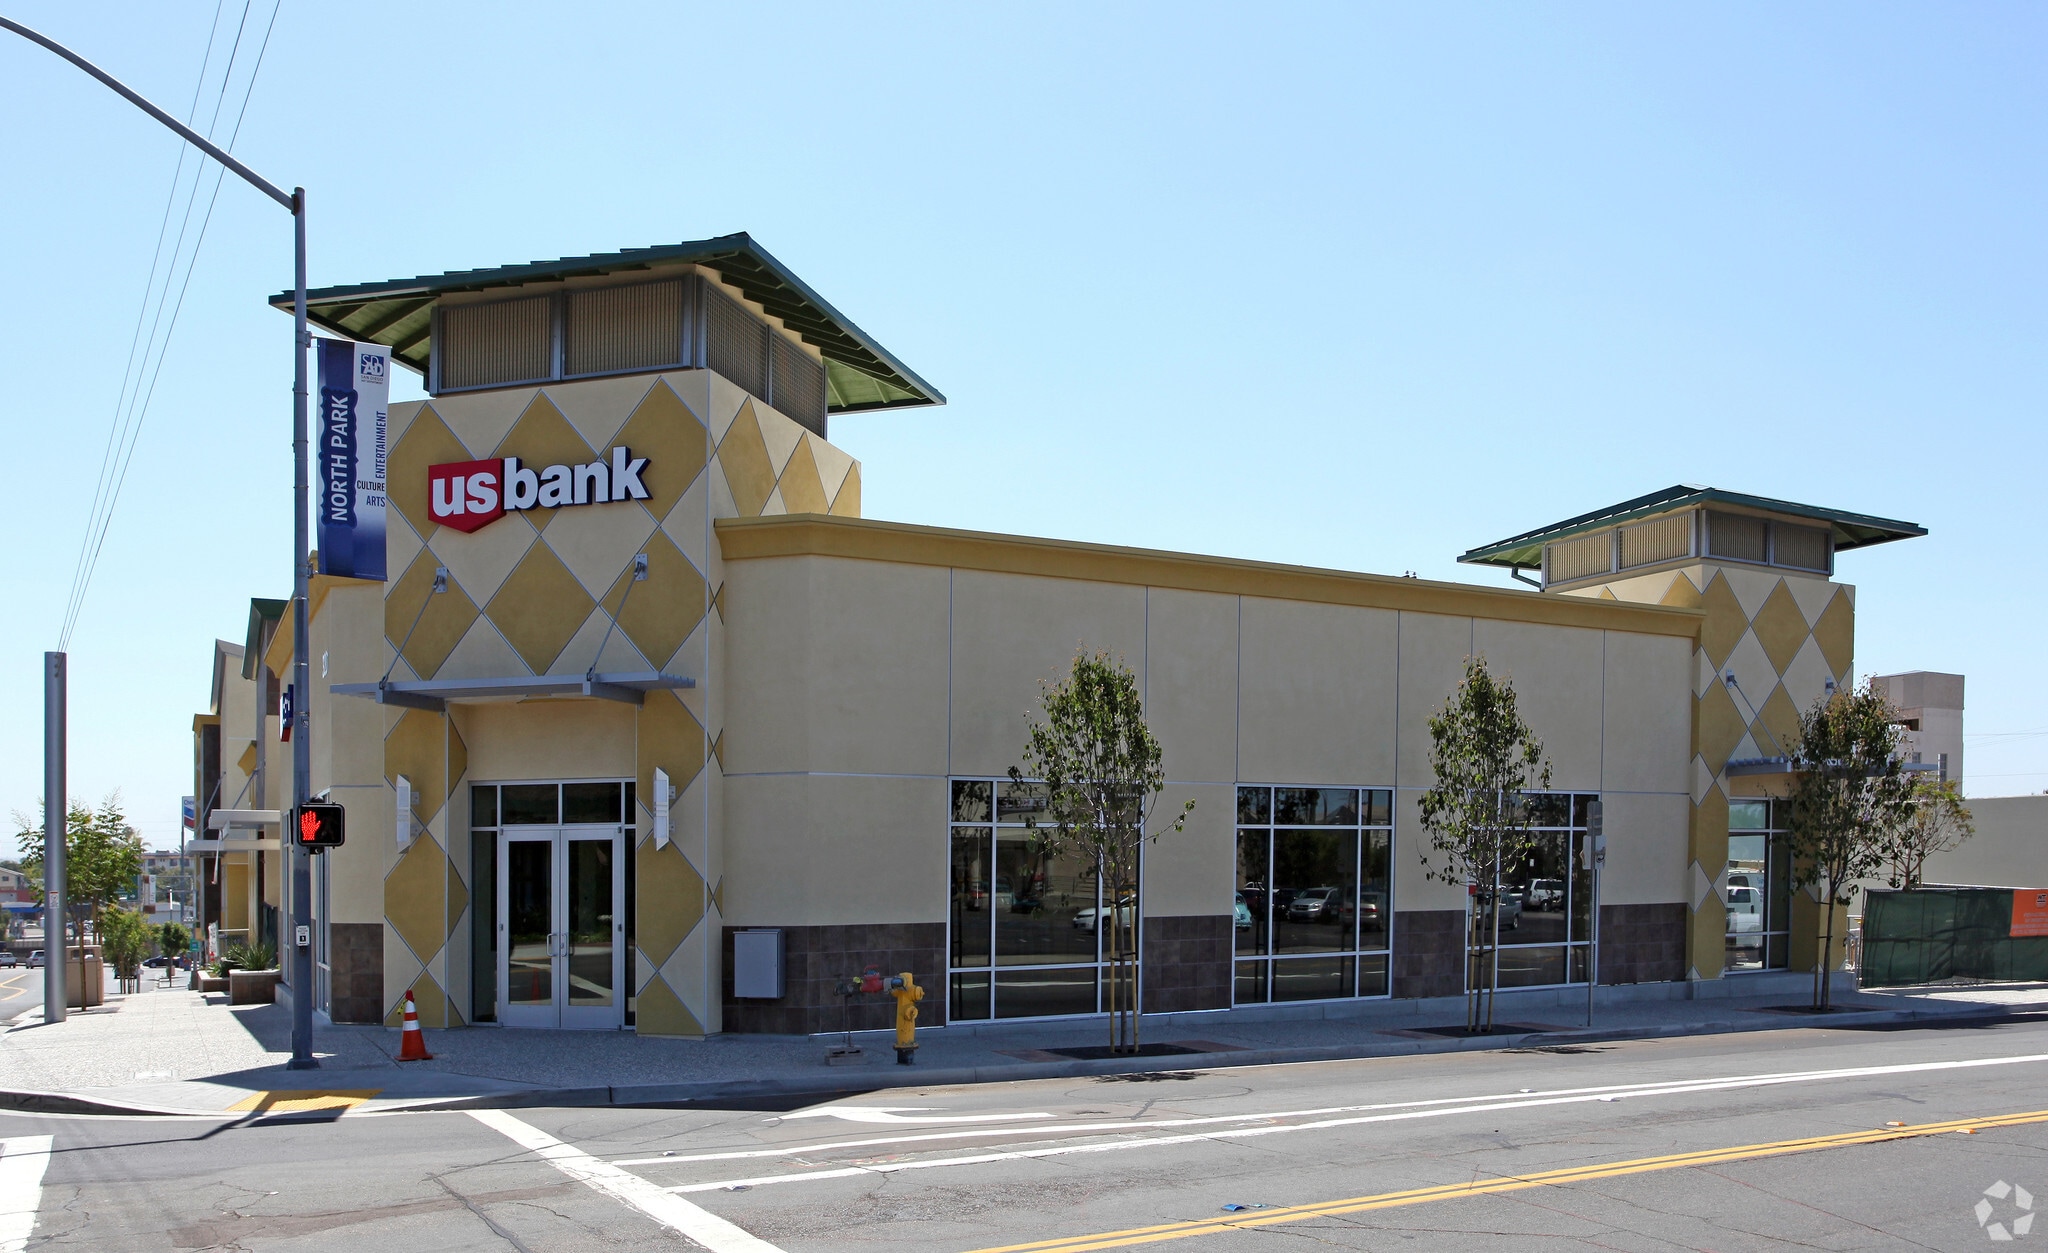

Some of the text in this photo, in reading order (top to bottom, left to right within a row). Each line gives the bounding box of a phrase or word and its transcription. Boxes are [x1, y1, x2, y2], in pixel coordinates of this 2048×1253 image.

[331, 395, 348, 521] NORTH PARK
[375, 411, 387, 478] ENTERTAINMENT
[357, 480, 385, 492] CULTURE
[366, 495, 386, 507] ARTS
